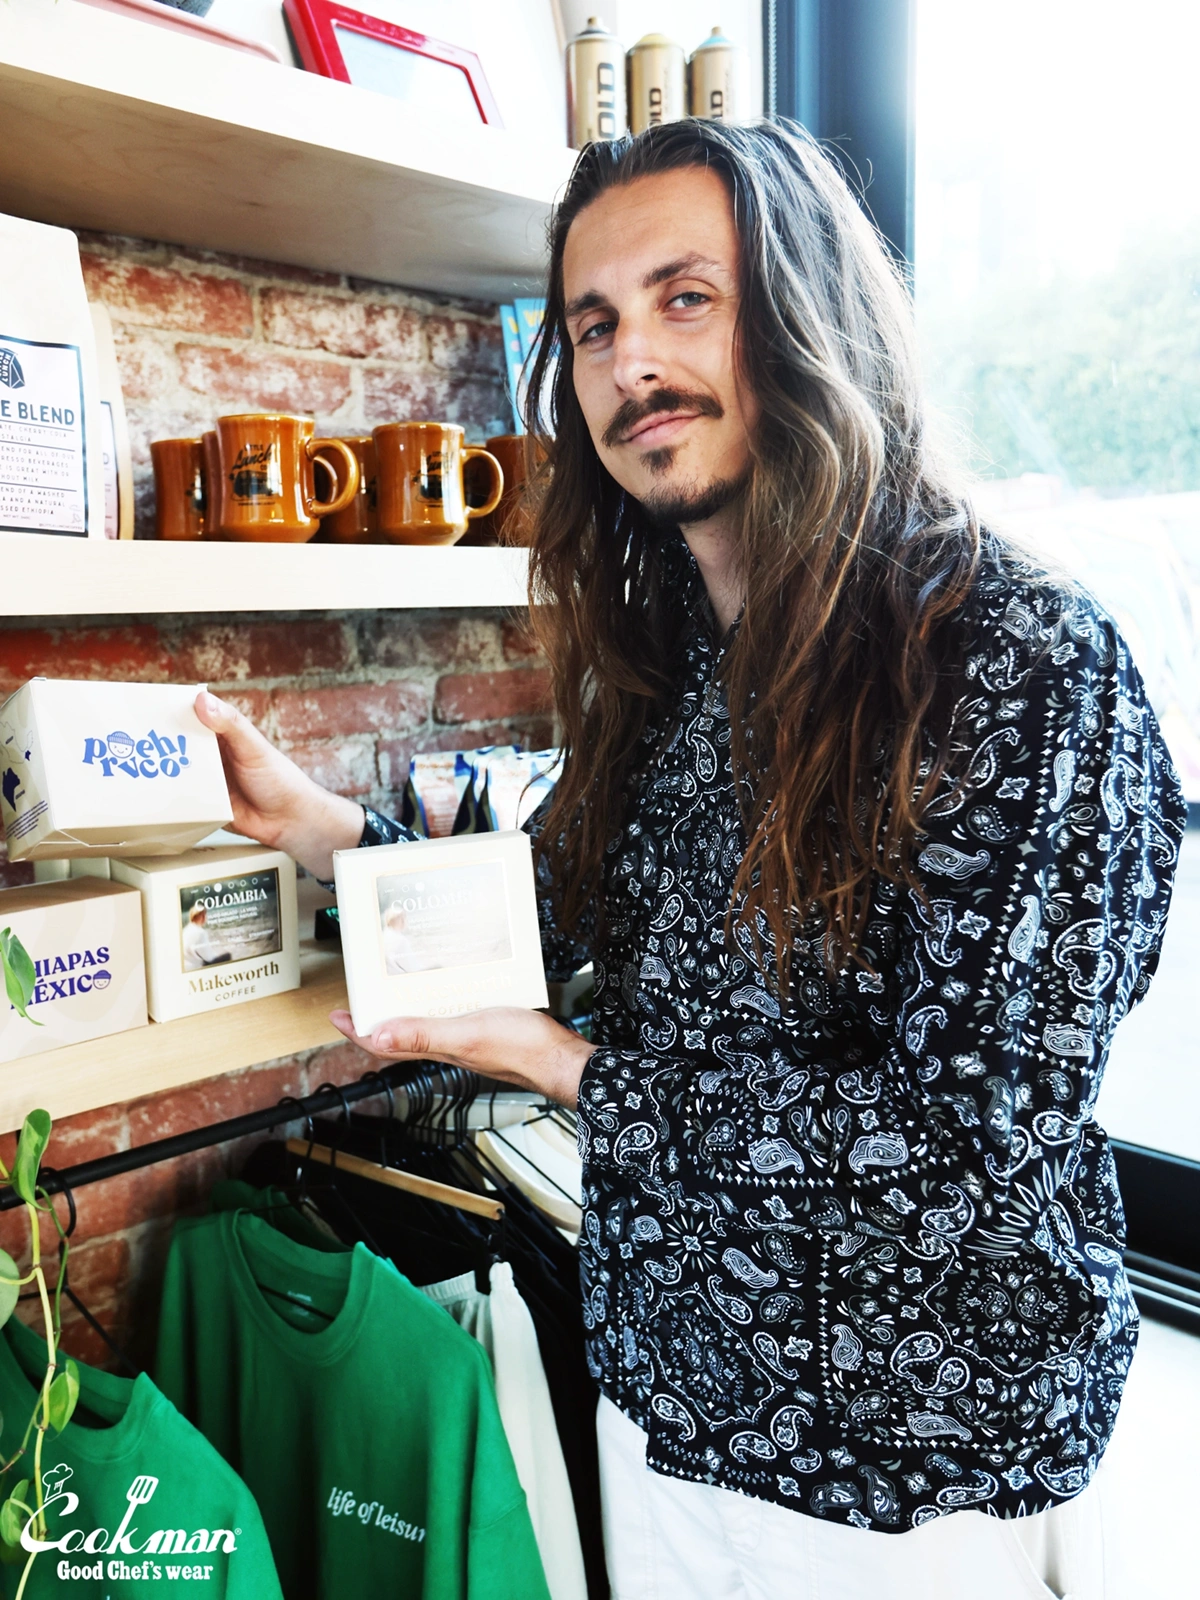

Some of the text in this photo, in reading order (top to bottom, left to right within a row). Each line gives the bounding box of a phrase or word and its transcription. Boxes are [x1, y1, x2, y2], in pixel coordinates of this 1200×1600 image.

[18, 402, 75, 426] BLEND
[18, 426, 46, 435] CHERRY
[18, 447, 32, 455] FOR
[28, 457, 69, 469] BEVERAGES
[16, 465, 39, 474] GREAT
[37, 490, 65, 499] WASHED
[10, 496, 24, 504] AND
[34, 499, 65, 508] NATURAL
[21, 506, 55, 516] ETHIOPIA
[194, 888, 268, 911] COLOMBIA
[188, 961, 280, 995] Makeworth
[215, 985, 256, 1002] COFFEE
[427, 1001, 483, 1017] COFFEE
[327, 1486, 356, 1517] life
[357, 1501, 379, 1525] of
